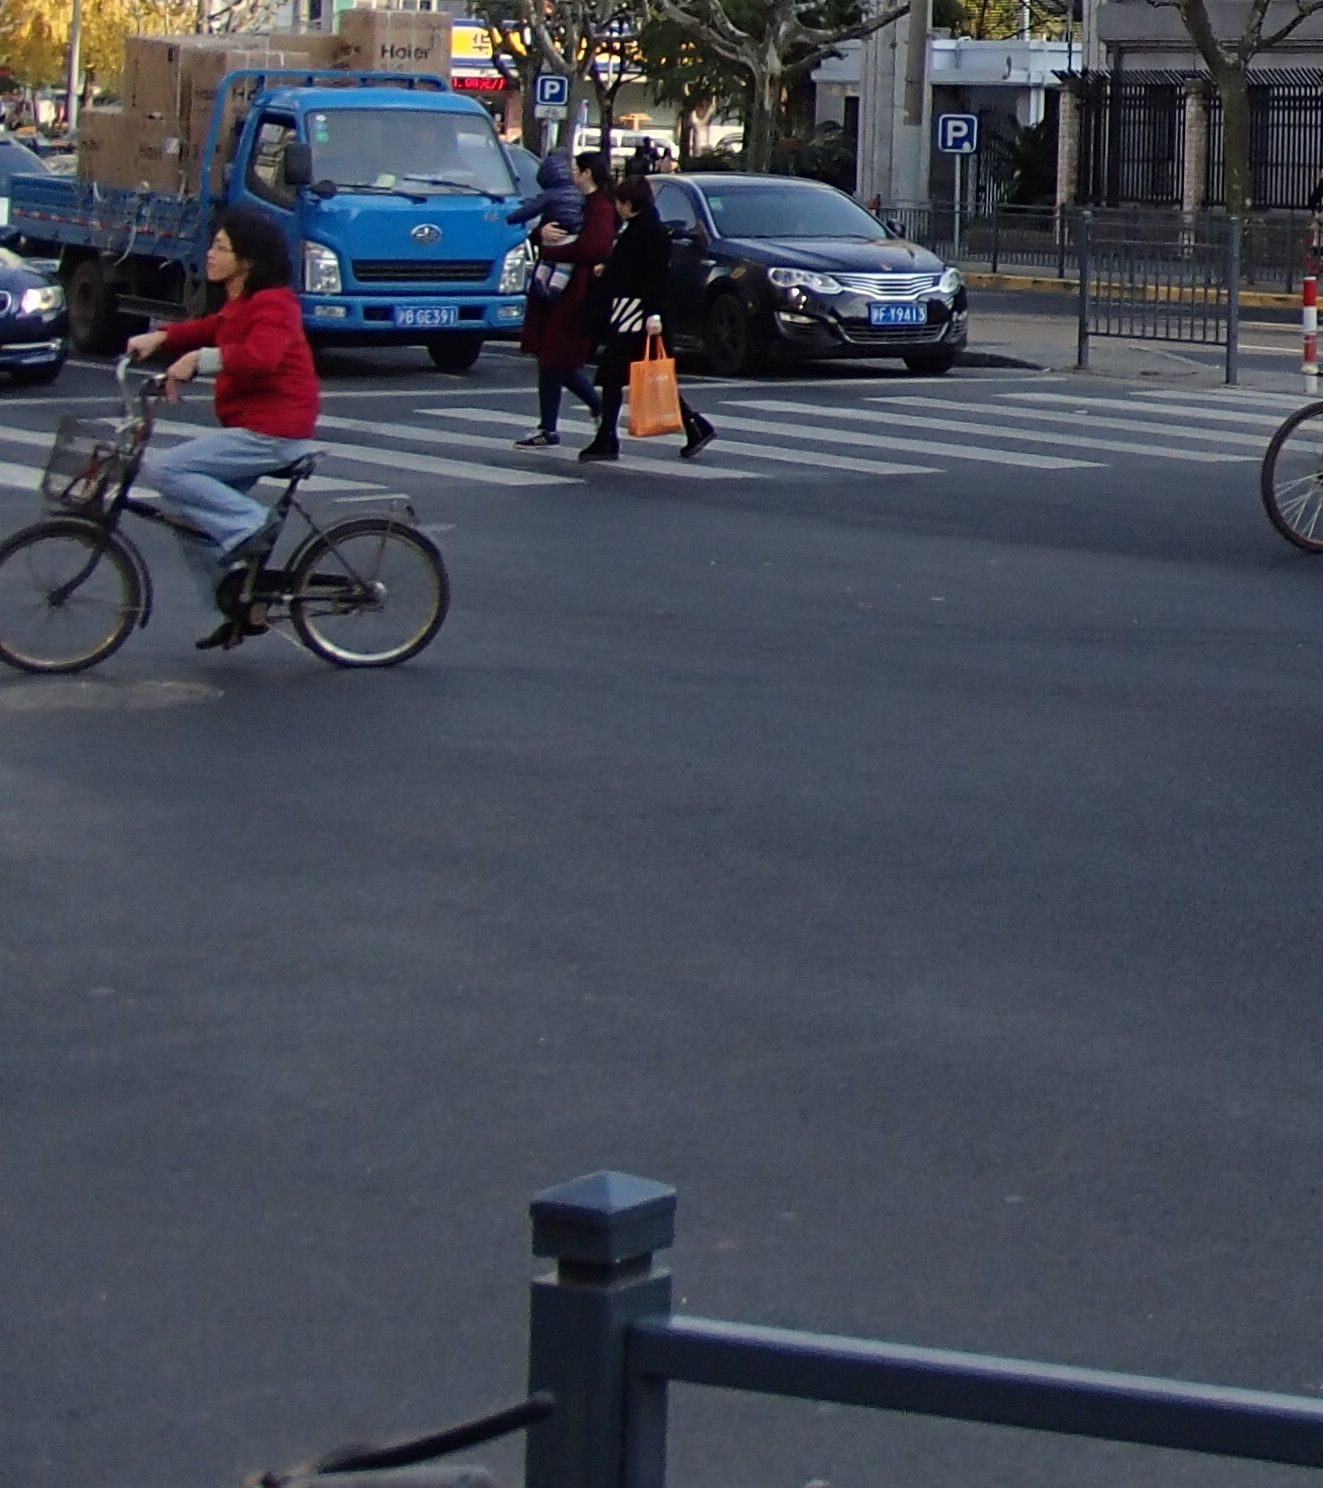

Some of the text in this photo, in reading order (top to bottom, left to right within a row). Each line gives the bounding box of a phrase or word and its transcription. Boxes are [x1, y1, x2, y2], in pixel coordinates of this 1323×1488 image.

[380, 44, 431, 60] Haier
[543, 81, 561, 100] P
[946, 120, 969, 147] P
